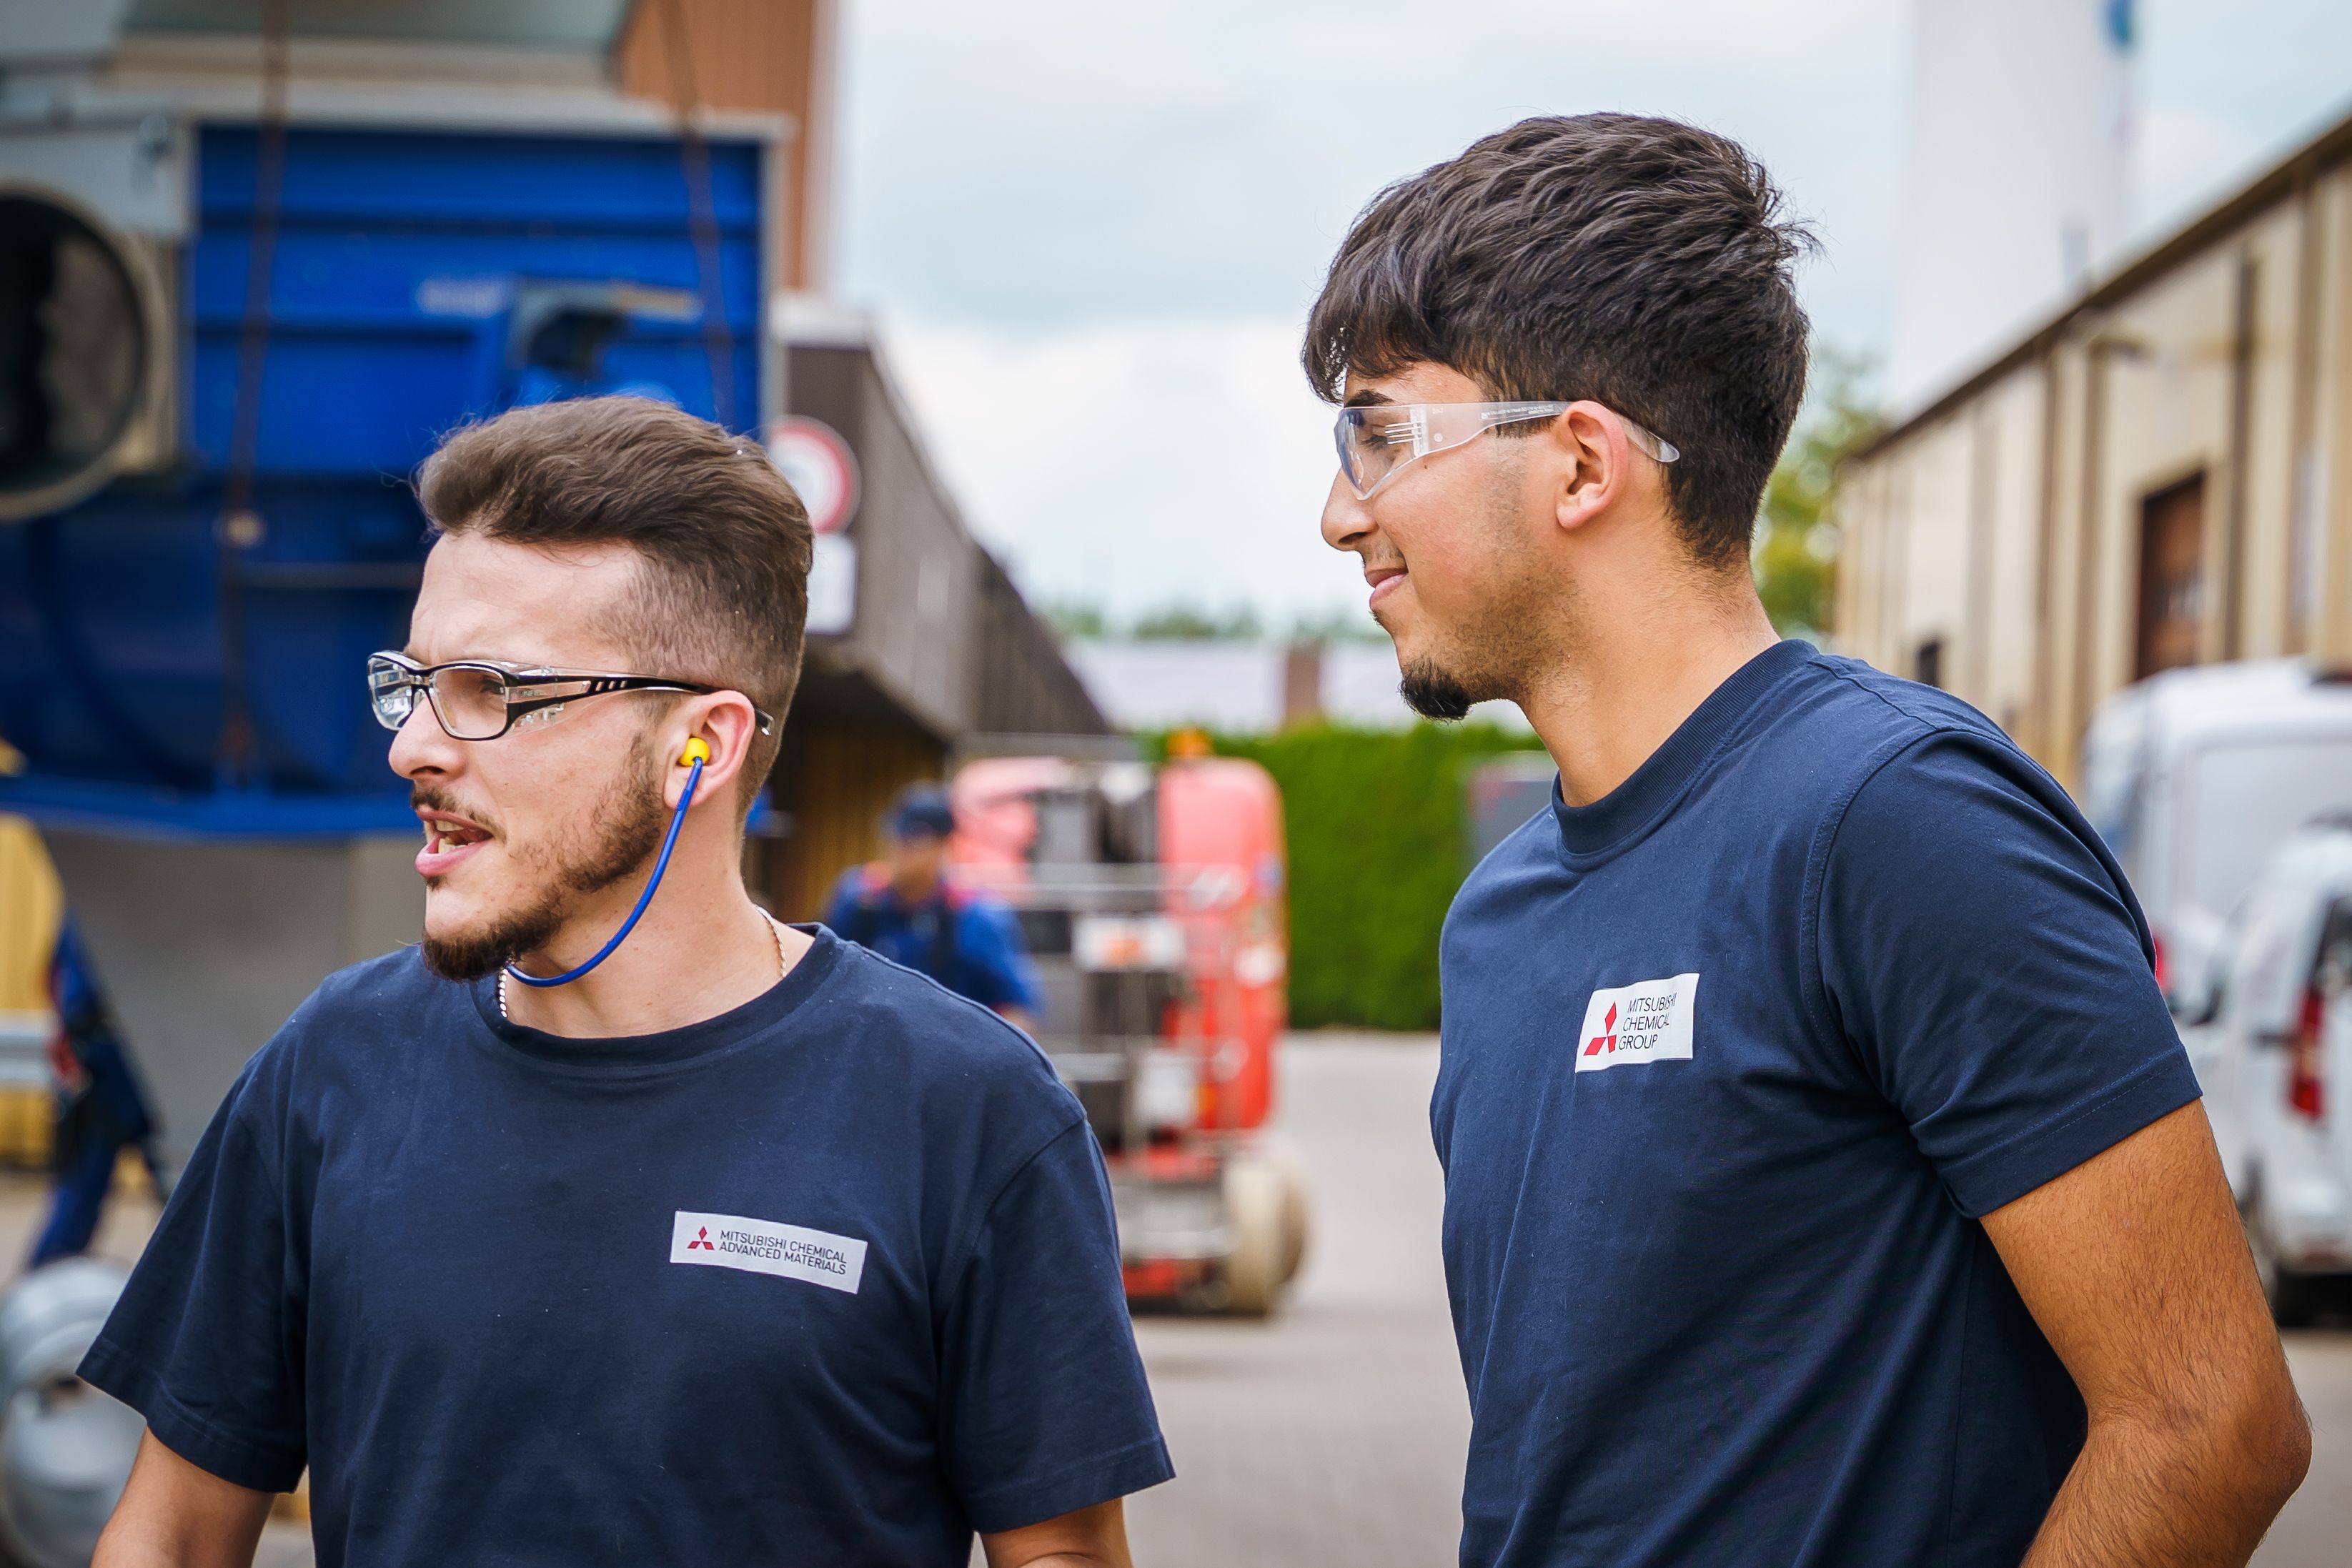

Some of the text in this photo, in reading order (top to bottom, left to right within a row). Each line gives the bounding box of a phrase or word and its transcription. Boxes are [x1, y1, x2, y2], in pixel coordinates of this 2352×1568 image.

[1618, 1034, 1658, 1051] GROUP
[719, 1241, 847, 1275] ADVANCED MATERIALS
[720, 1230, 847, 1264] MITSUBISHI CHEMICAL
